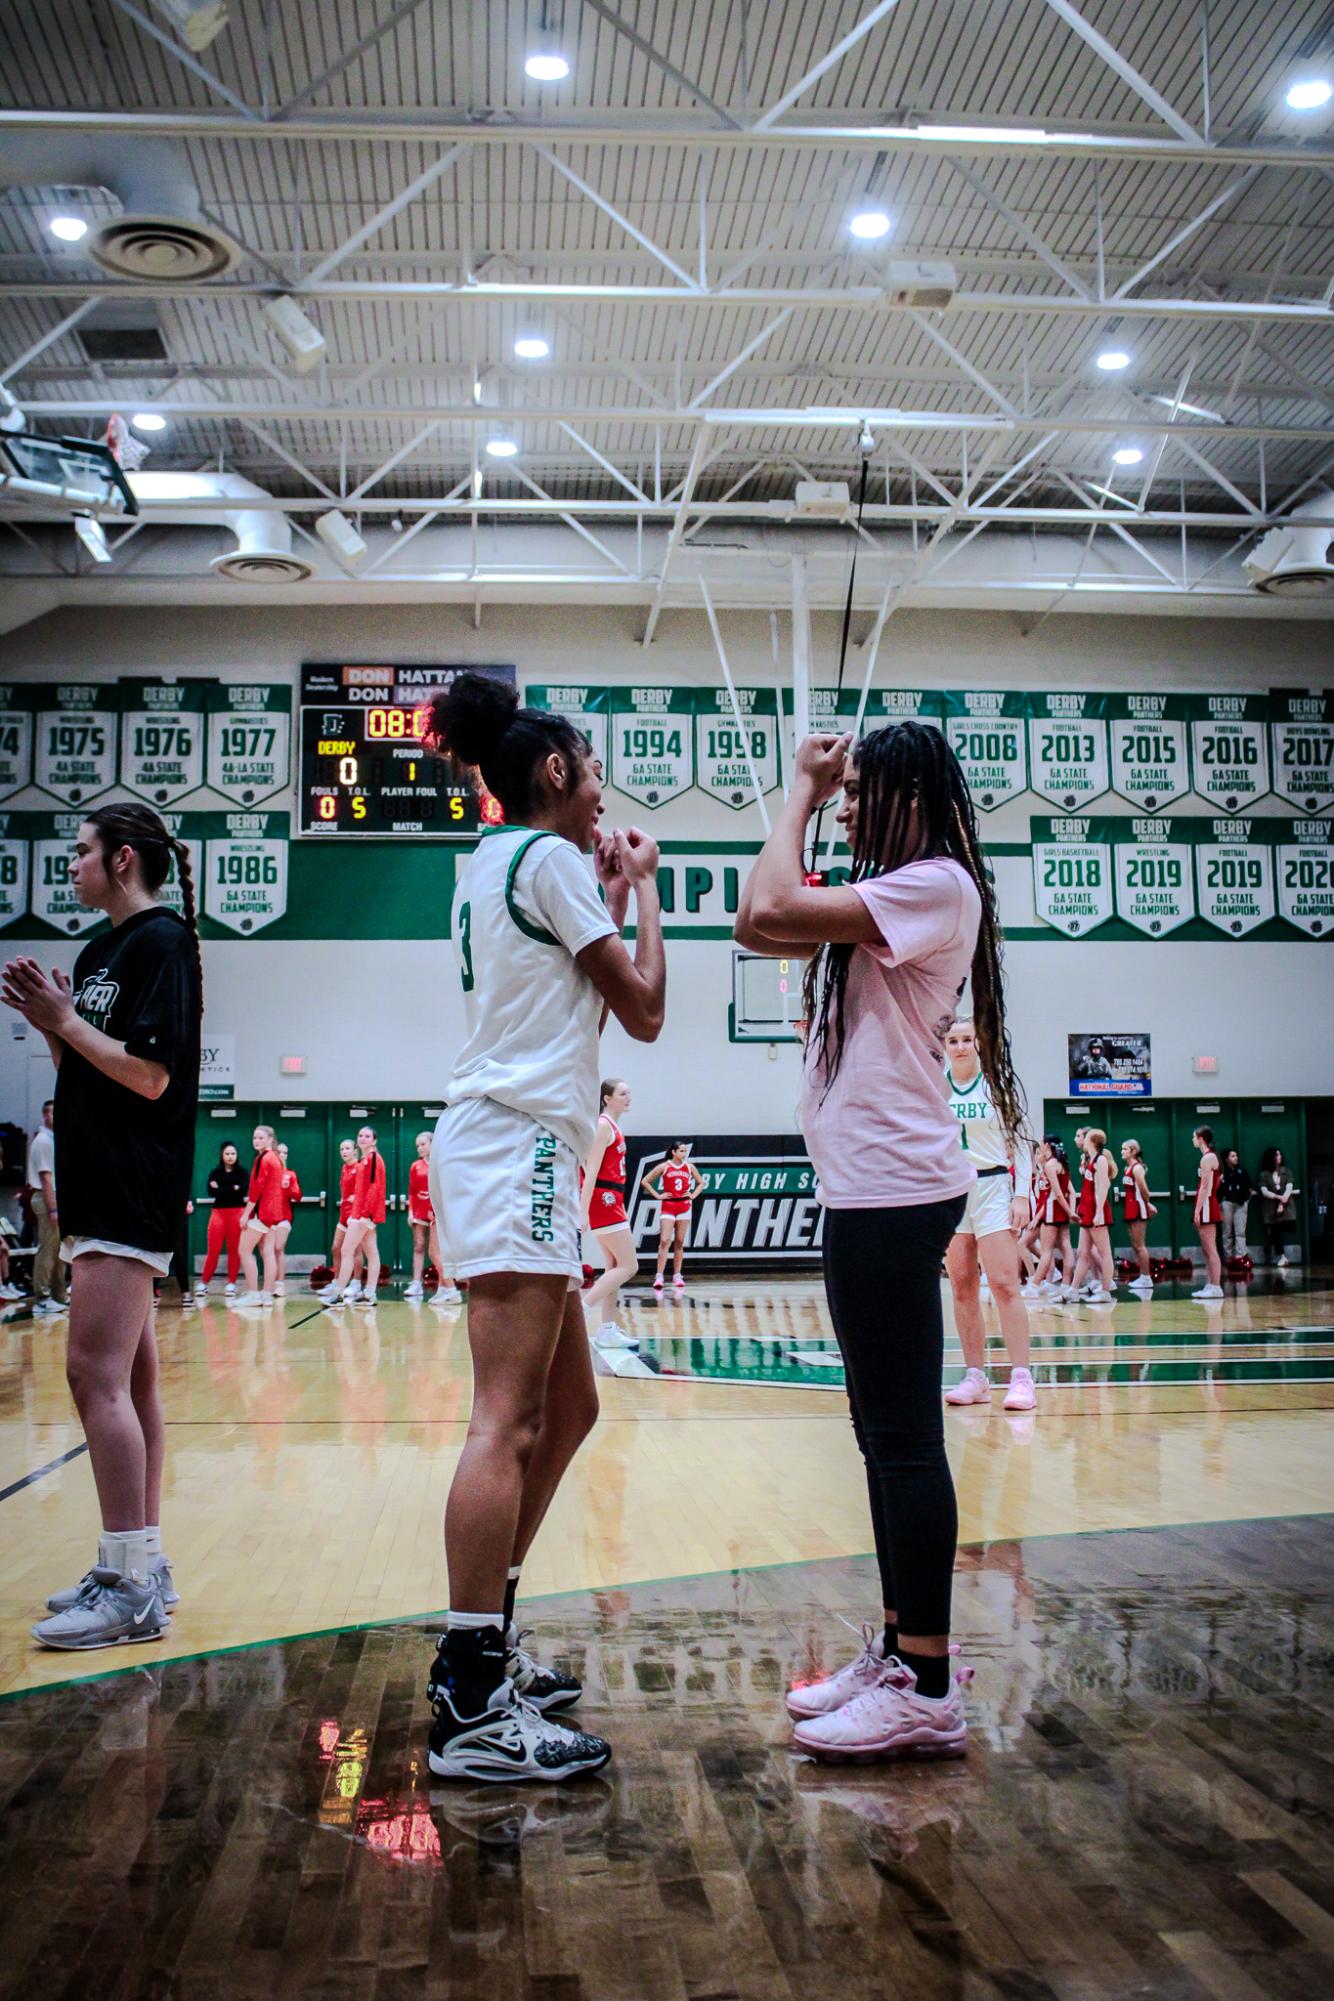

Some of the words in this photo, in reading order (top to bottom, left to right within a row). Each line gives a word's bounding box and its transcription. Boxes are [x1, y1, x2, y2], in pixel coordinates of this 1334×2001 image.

[348, 669, 390, 683] DON
[398, 670, 464, 684] HATTA
[143, 687, 184, 702] DERBY
[228, 688, 270, 702] DERBY
[348, 688, 388, 702] DON
[546, 688, 588, 704] DERBY
[631, 689, 672, 704] DERBY
[808, 691, 838, 706] ERBY
[882, 692, 922, 708] DERBY
[964, 693, 1006, 708] DERBY
[1046, 694, 1086, 710] DERBY
[1128, 696, 1166, 711] DERBY
[1208, 698, 1247, 712] DERBY
[1288, 699, 1326, 713] DERBY
[369, 710, 424, 738] 08:0
[1214, 726, 1243, 734] FOOTBALL
[48, 727, 104, 756] 1975
[134, 728, 192, 757] 1976
[221, 728, 276, 757] 1977
[318, 741, 356, 755] DERBY
[623, 730, 682, 758] 1994
[955, 734, 1018, 761] 2008
[393, 749, 424, 758] PERIOD
[1042, 736, 1095, 762] 2013
[1122, 736, 1176, 763] 2015
[1202, 737, 1258, 764] 2016
[1283, 738, 1334, 766] 2017
[142, 762, 155, 772] 4A
[156, 762, 182, 772] STATE
[250, 763, 274, 773] STATE
[340, 757, 358, 785] 0
[632, 764, 645, 774] 6A
[647, 764, 672, 774] STATE
[718, 765, 730, 775] 6A
[968, 768, 979, 777] 6A
[981, 768, 1006, 777] STATE
[1050, 768, 1061, 778] 6A
[1064, 768, 1088, 778] STATE
[49, 774, 101, 784] CHAMPIONS
[135, 774, 188, 785] CHAMPIONS
[222, 775, 274, 785] CHAMPIONS
[626, 776, 678, 786] CHAMPIONS
[1130, 769, 1142, 780] 6A
[1144, 769, 1168, 780] STATE
[1212, 770, 1224, 780] 6A
[1226, 770, 1249, 780] STATE
[1292, 771, 1304, 781] 6A
[1305, 771, 1328, 781] STATE
[711, 777, 763, 787] CHAMPIOS
[967, 779, 1012, 789] HAMPIONS
[1044, 780, 1094, 790] CHAMPIONS
[1126, 781, 1174, 791] CHAMPIONS
[1207, 782, 1256, 792] CHAMPIONS
[310, 786, 338, 796] FOULS
[381, 787, 414, 796] PLAYER
[416, 787, 438, 796] FOUL
[320, 796, 336, 819] 0
[226, 814, 269, 830] DERBY
[392, 822, 423, 832] MATCH
[1050, 818, 1090, 834] DERBY
[1132, 820, 1172, 834] DERBY
[1213, 820, 1252, 834] DERBY
[1293, 821, 1332, 836] DERBY
[1299, 850, 1328, 858] FOOTBALL
[217, 856, 278, 884] 1986
[1044, 860, 1101, 888] 2018
[1126, 860, 1182, 888] 2019
[1208, 860, 1262, 888] 2019
[226, 890, 238, 900] 6A
[241, 890, 267, 900] STATE
[1054, 893, 1066, 904] 6A
[1068, 893, 1092, 904] STATE
[1136, 894, 1148, 904] 6A
[1149, 894, 1174, 904] STATE
[1216, 894, 1228, 904] 6A
[1230, 894, 1254, 904] STATE
[1296, 894, 1308, 904] 6A
[1310, 894, 1334, 904] STATE
[220, 903, 273, 913] CHAMPIONS
[1048, 905, 1099, 916] CHAMPIONS
[1130, 905, 1180, 916] CHAMPIONS
[1211, 906, 1260, 916] CHAMPIONS
[1291, 906, 1334, 916] CHAMPION
[674, 1178, 682, 1191] 3
[736, 1172, 788, 1190] HIGH
[531, 1137, 556, 1242] PANTHERS
